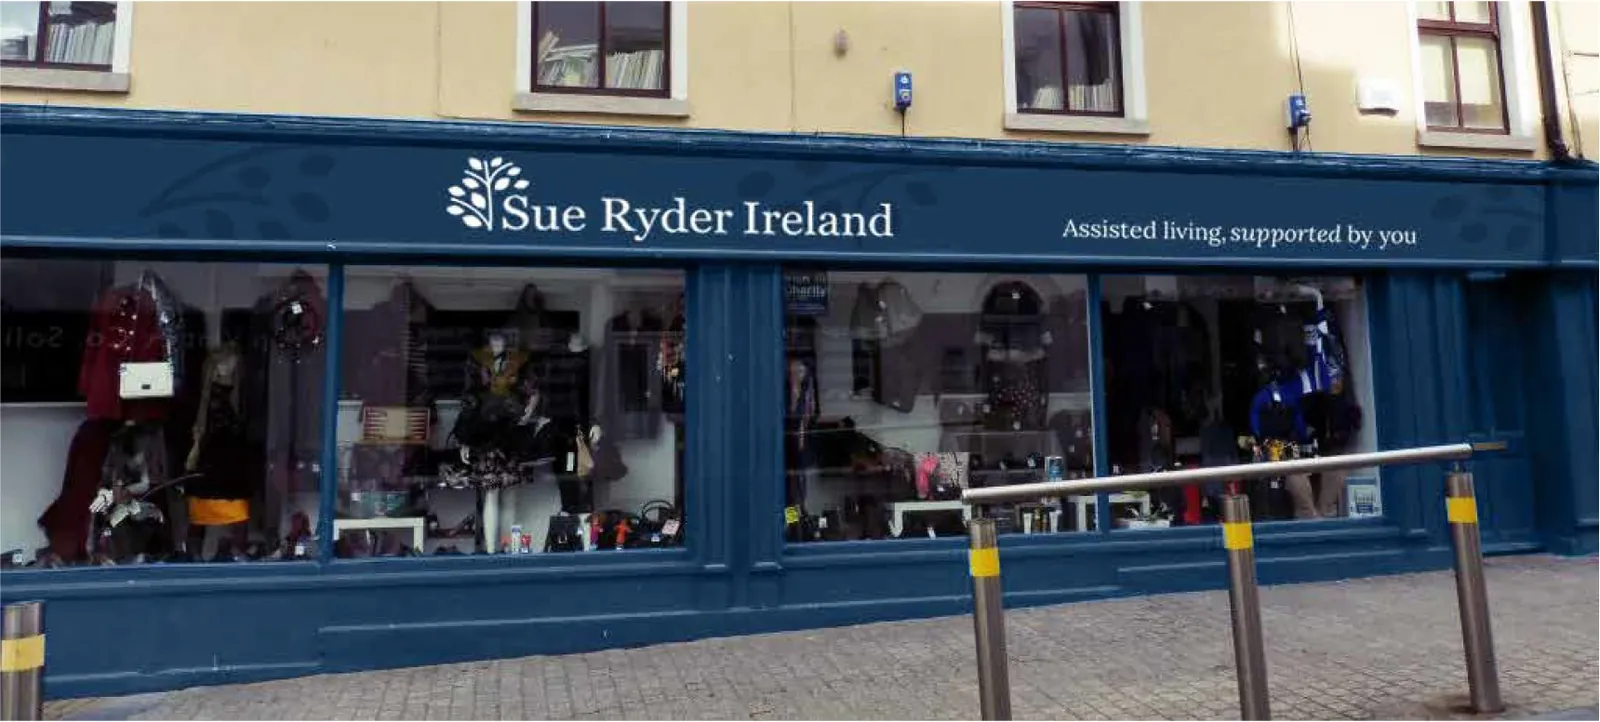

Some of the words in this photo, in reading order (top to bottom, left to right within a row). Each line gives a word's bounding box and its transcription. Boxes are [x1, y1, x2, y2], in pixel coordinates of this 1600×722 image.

[501, 194, 586, 232] Sue
[600, 196, 734, 242] Ryder
[743, 200, 894, 238] Ireland
[1062, 218, 1157, 240] Assisted
[1163, 220, 1227, 247] living,
[1229, 223, 1342, 248] supported
[1347, 224, 1374, 250] by
[1379, 230, 1417, 250] you
